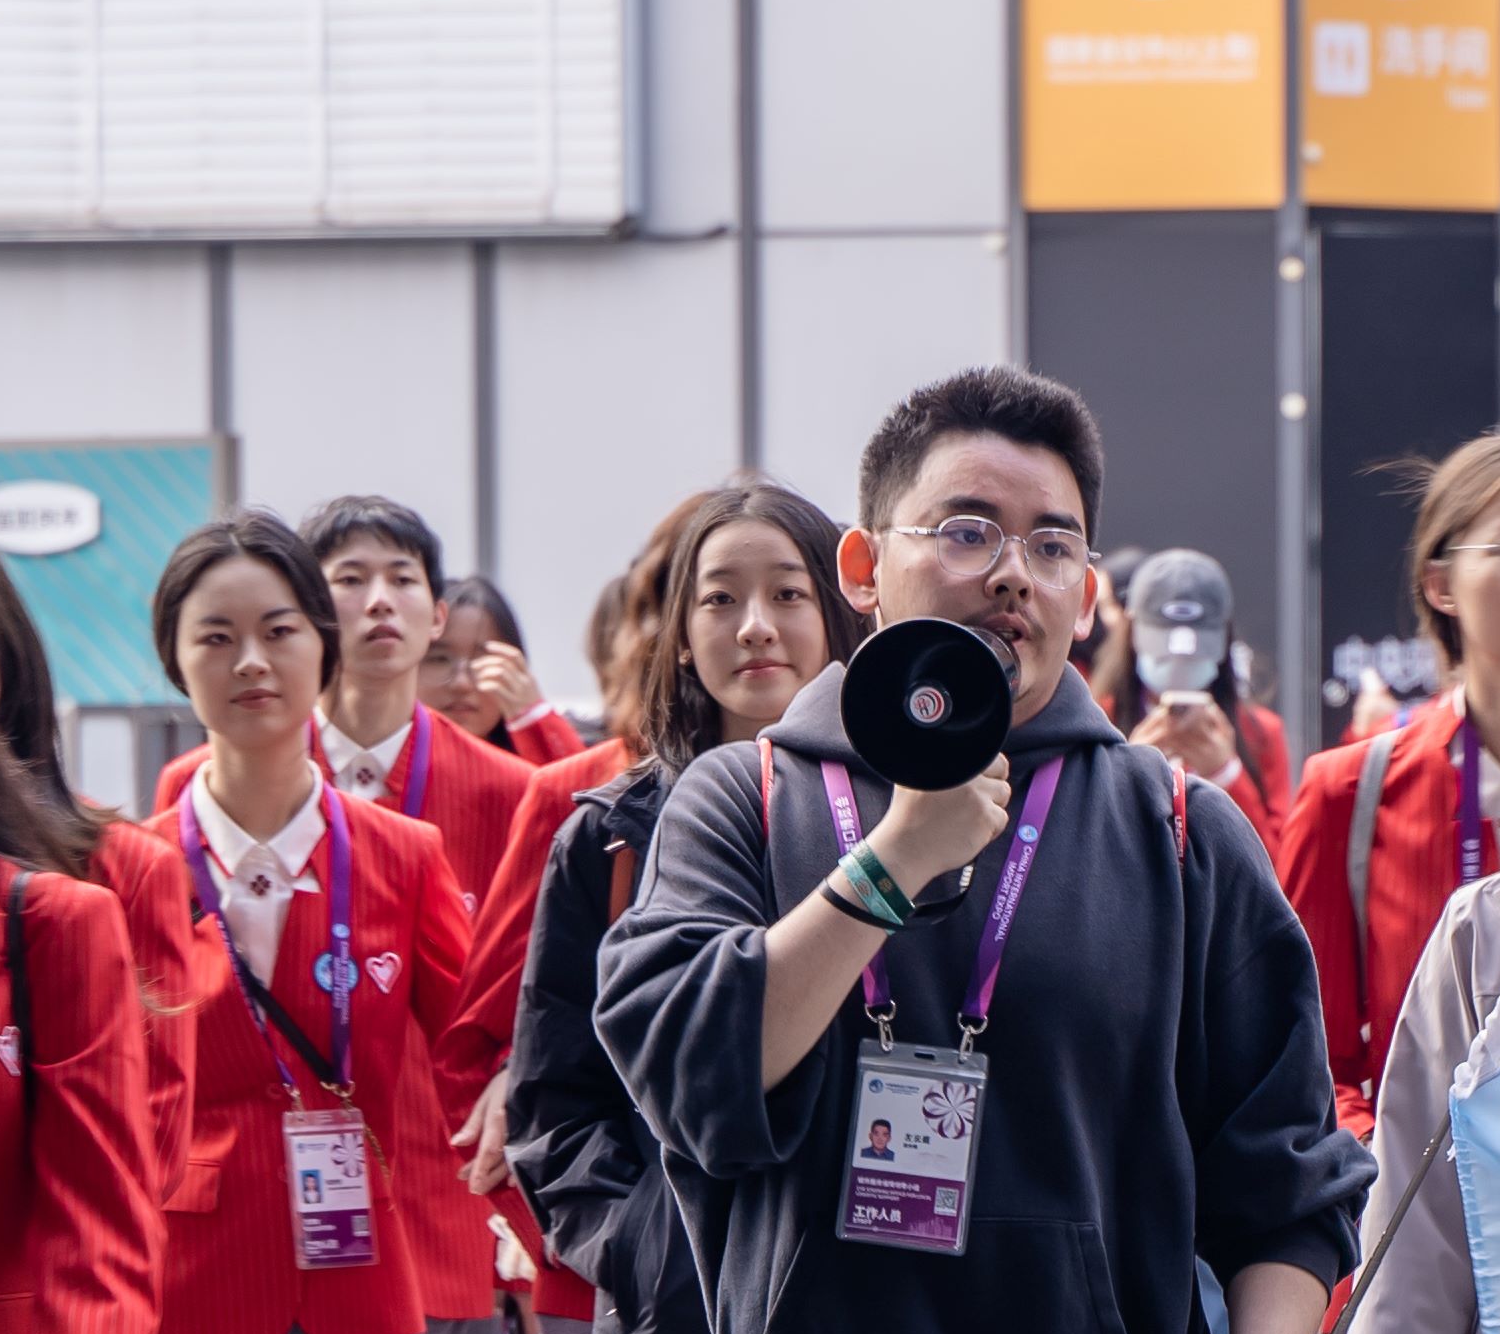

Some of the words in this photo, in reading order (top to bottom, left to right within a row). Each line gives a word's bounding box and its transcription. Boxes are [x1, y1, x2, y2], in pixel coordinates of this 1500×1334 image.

[1017, 845, 1033, 873] CHINA
[1000, 860, 1018, 895] IMPORT
[992, 894, 1007, 921] EXPO
[994, 872, 1024, 942] INTERNATIONAL
[852, 1204, 902, 1224] 工作人员
